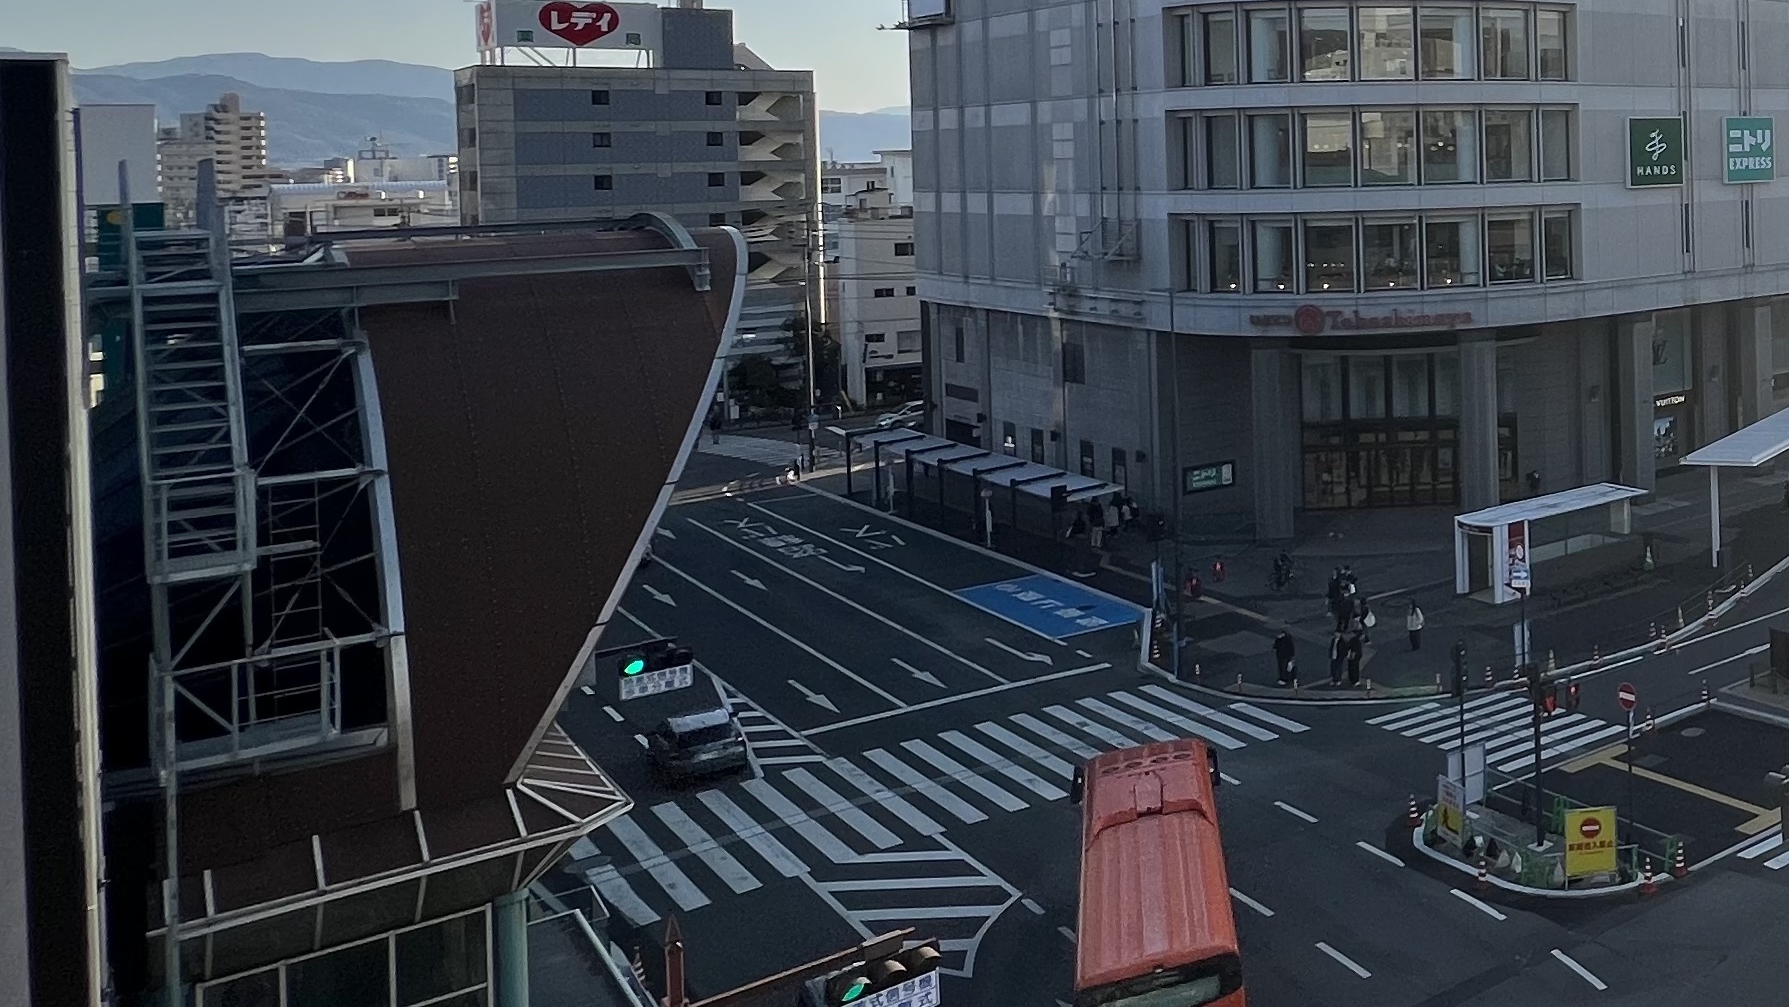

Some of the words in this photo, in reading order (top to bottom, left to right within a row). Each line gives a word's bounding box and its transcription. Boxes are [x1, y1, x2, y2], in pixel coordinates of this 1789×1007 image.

[1729, 129, 1771, 152] ニトリ
[1636, 164, 1677, 176] HANDS
[1729, 156, 1772, 170] EXPRESS
